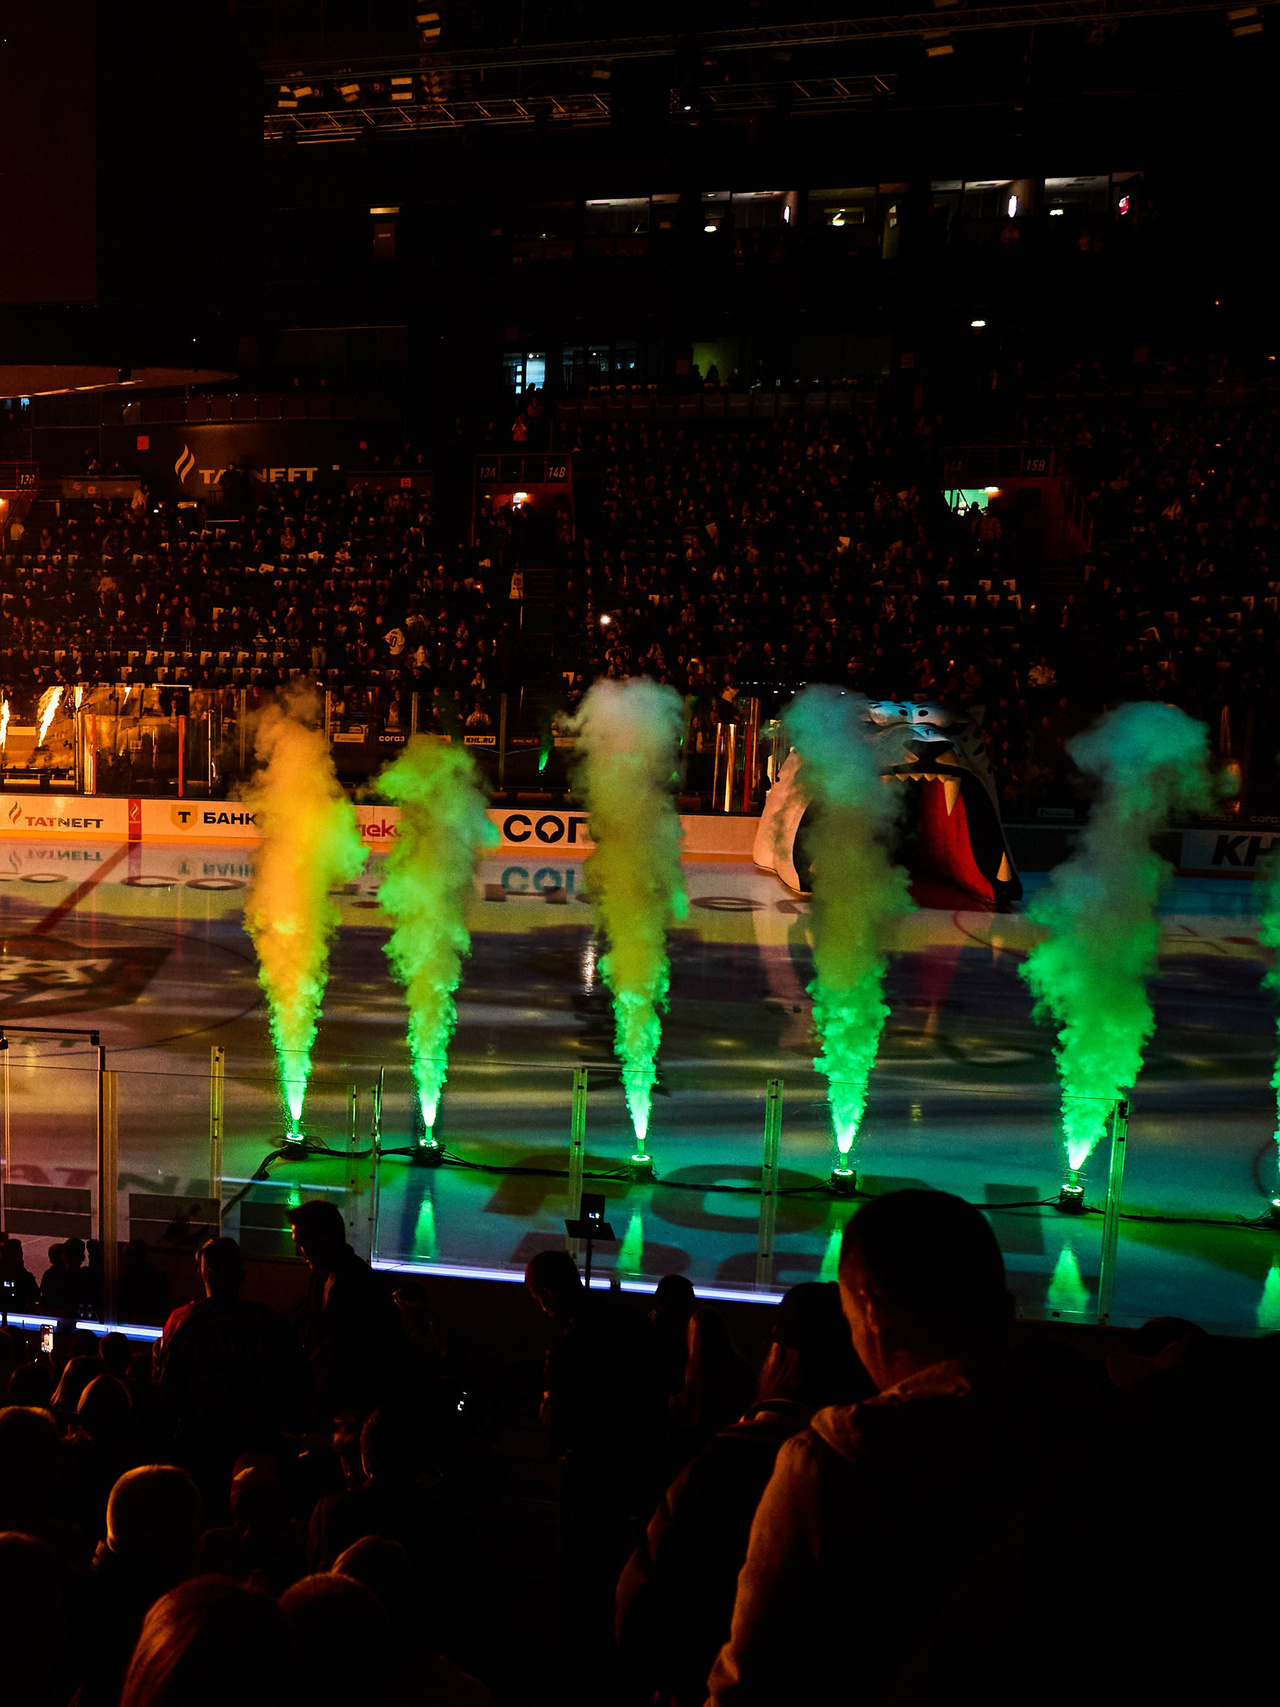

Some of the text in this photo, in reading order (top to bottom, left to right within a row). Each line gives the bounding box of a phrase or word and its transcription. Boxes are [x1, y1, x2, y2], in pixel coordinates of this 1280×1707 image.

[199, 467, 319, 484] TANEFT
[24, 816, 104, 829] TATNEFT
[203, 812, 259, 825] БАНК
